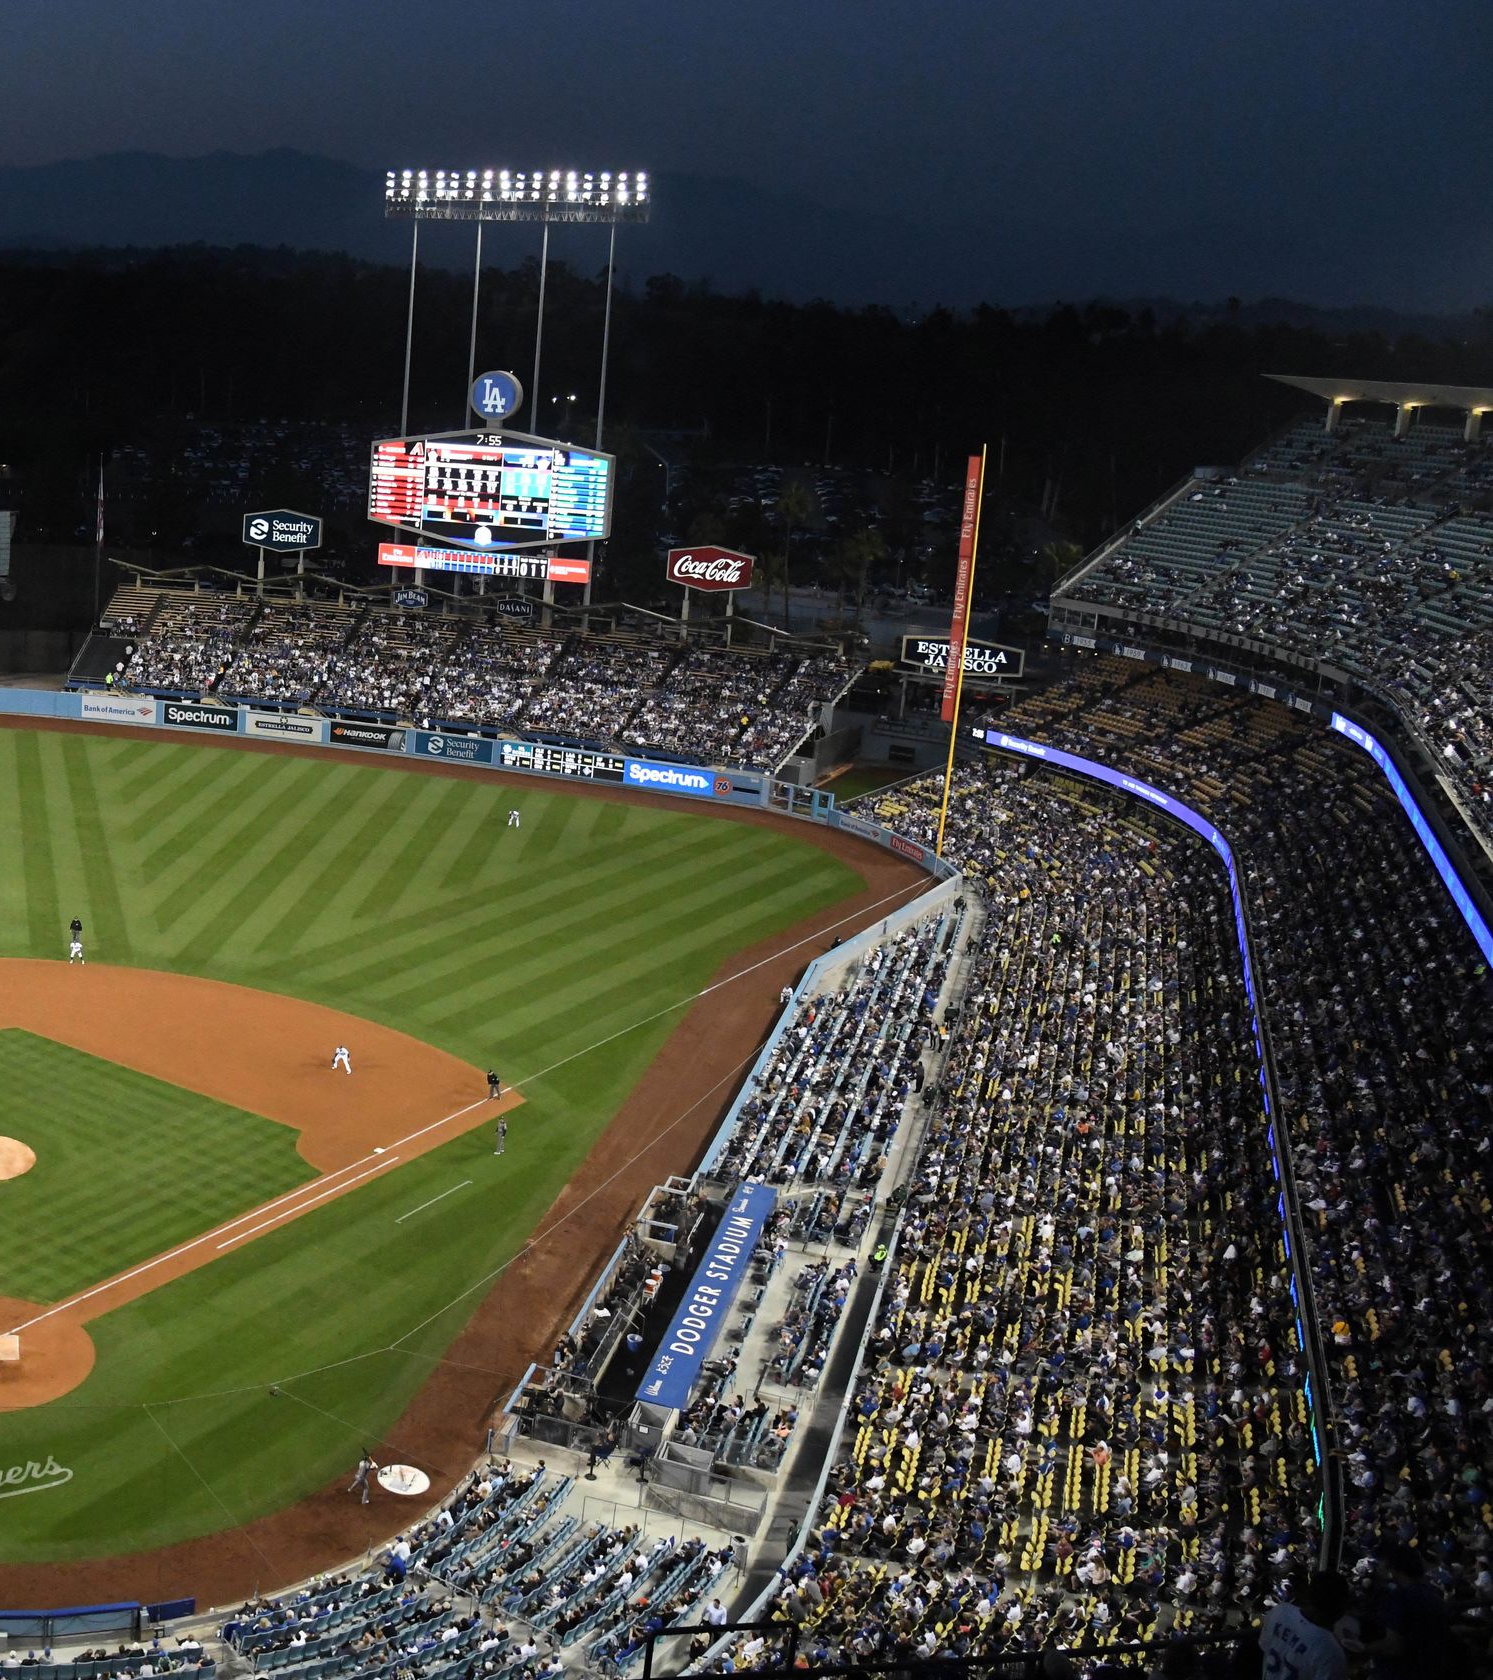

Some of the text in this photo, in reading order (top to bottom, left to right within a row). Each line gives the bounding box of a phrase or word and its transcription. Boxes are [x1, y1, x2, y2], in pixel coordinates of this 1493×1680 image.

[483, 379, 506, 413] LA
[476, 434, 502, 446] 7:55
[272, 520, 313, 535] Security
[272, 531, 307, 544] Benefit
[408, 591, 426, 605] BEAM
[499, 603, 530, 613] DASANI
[917, 641, 1007, 664] ESTELLA
[83, 704, 136, 716] Bank of America
[168, 707, 230, 726] Spectrum
[257, 722, 310, 733] ESTRELLA JALISCO
[446, 737, 480, 752] Security
[446, 747, 474, 759] Benefit
[630, 764, 706, 788] Spectrum
[716, 780, 730, 791] 76
[670, 1216, 754, 1355] DODGER STADIUM
